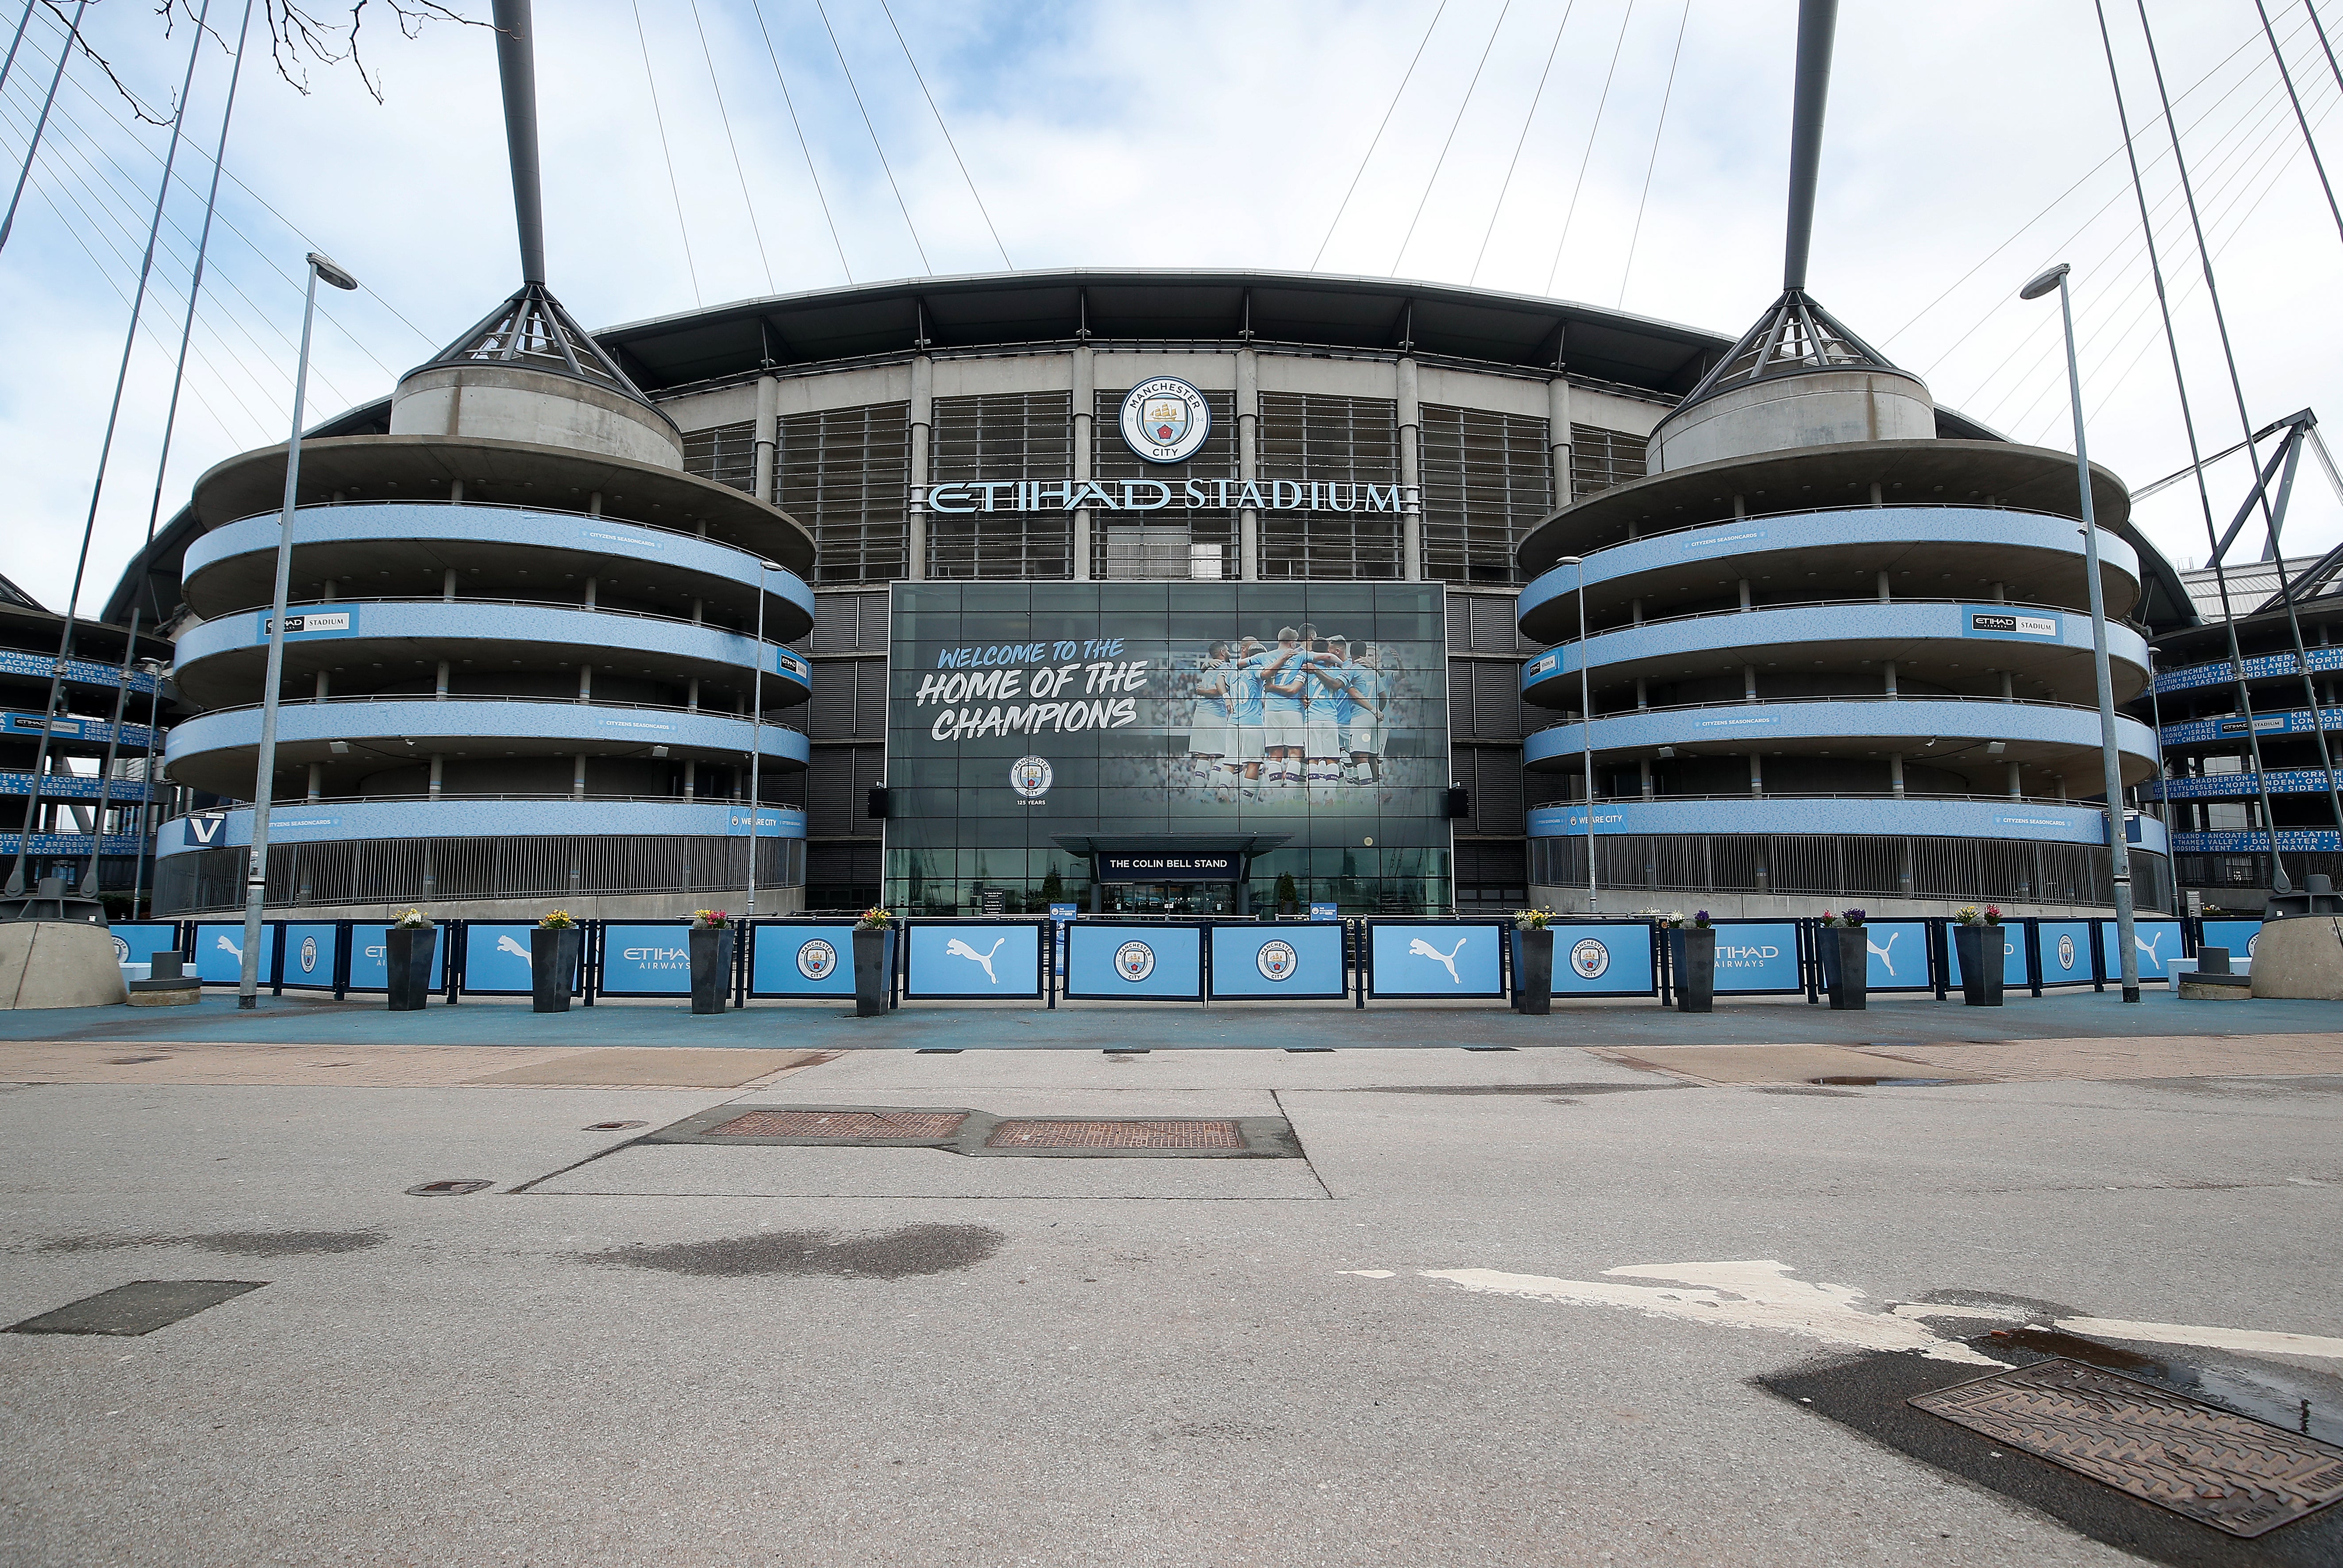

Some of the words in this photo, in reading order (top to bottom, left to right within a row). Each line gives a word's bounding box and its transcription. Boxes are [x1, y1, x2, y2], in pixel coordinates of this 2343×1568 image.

[1129, 383, 1200, 409] MANCHESTER
[928, 480, 1172, 514] ETIHAD
[1184, 477, 1402, 515] STADIUM
[617, 536, 655, 547] SEASONCARDS
[1691, 538, 1716, 547] CITYZENS
[1717, 533, 1757, 542] SEASONCARDS
[2021, 622, 2051, 630] STADIUM
[937, 642, 1046, 669] WELCOME
[1052, 640, 1077, 661] TO
[1083, 637, 1125, 659] THE
[64, 660, 105, 672] ARIZONA
[2218, 657, 2266, 670] CITZENS
[2270, 652, 2315, 663] KERAA
[2154, 666, 2209, 682] GELSENKIRCHEN
[2182, 671, 2218, 682] BAGULEY
[2195, 675, 2216, 686] EAST
[2217, 671, 2267, 682] MIDNDS
[85, 676, 130, 689] YORKSHIE
[916, 669, 1022, 707] HOME
[1029, 663, 1082, 699] OF
[1084, 660, 1148, 695] THE
[2156, 678, 2177, 687] AUSTIN
[2166, 682, 2189, 691] MOON)
[930, 696, 1137, 742] CHAMPIONS
[2291, 710, 2327, 718] KINS
[85, 727, 114, 737] CREWE
[2292, 723, 2342, 731] MANFIE
[85, 734, 122, 744] DUNDAK
[2182, 734, 2216, 743] CHEADLE
[1014, 757, 1049, 772] MANCHESTER
[25, 781, 83, 791] CLERAINE
[51, 776, 100, 785] SCOTLAND
[2191, 775, 2248, 784] CHADDERTON
[2226, 779, 2295, 788] NORTHNDEN
[2197, 788, 2243, 796] RUSHOLME
[1605, 815, 1623, 823] CITY
[190, 819, 222, 843] V
[623, 947, 690, 960] ETIHA
[801, 942, 833, 955] MANCHESTER
[1118, 943, 1151, 956] MANCHESTER
[1260, 942, 1293, 956] MANCHESTER
[1574, 941, 1605, 954] MANCHESTER
[1715, 946, 1779, 959] TIHAD
